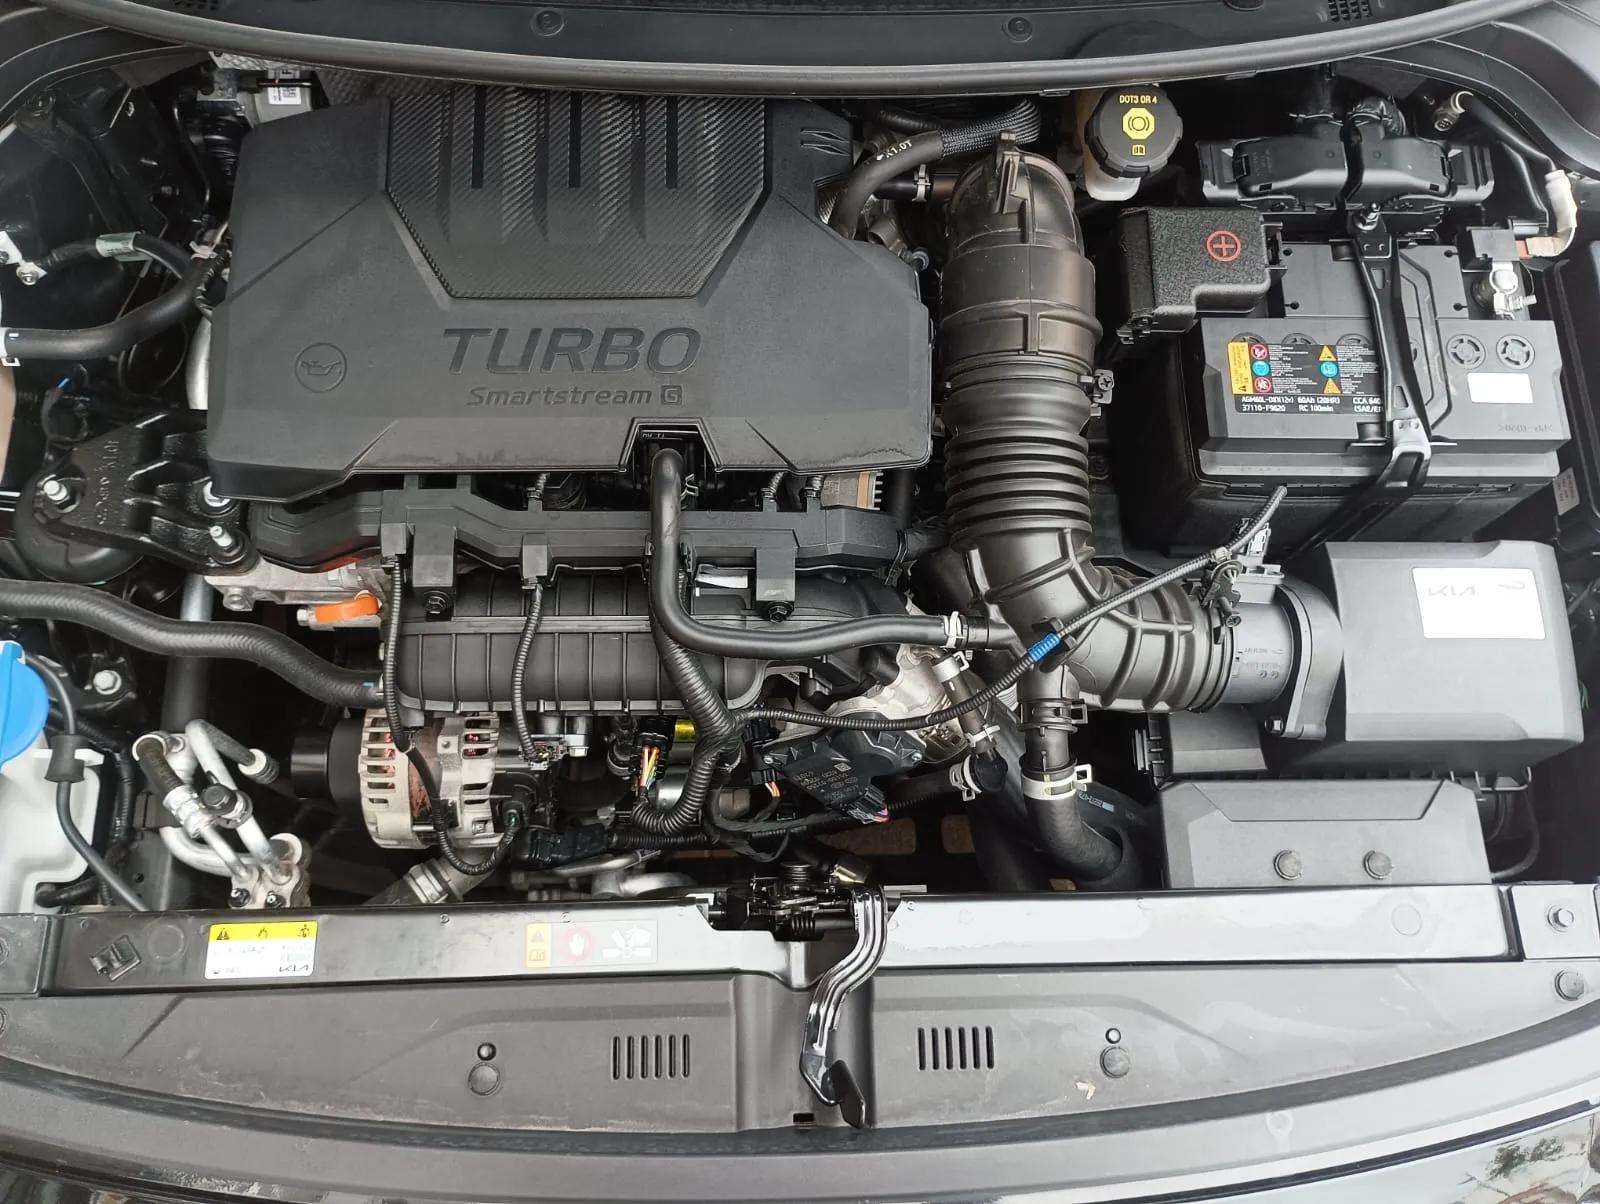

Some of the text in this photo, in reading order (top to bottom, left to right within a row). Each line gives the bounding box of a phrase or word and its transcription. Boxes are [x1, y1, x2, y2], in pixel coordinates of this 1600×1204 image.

[1119, 95, 1158, 104] DOT3 OR 4
[443, 327, 701, 374] TURBO
[466, 385, 653, 406] Smartstream
[1353, 396, 1369, 405] CCA
[1427, 584, 1477, 597] KIA
[279, 963, 310, 973] KIA
